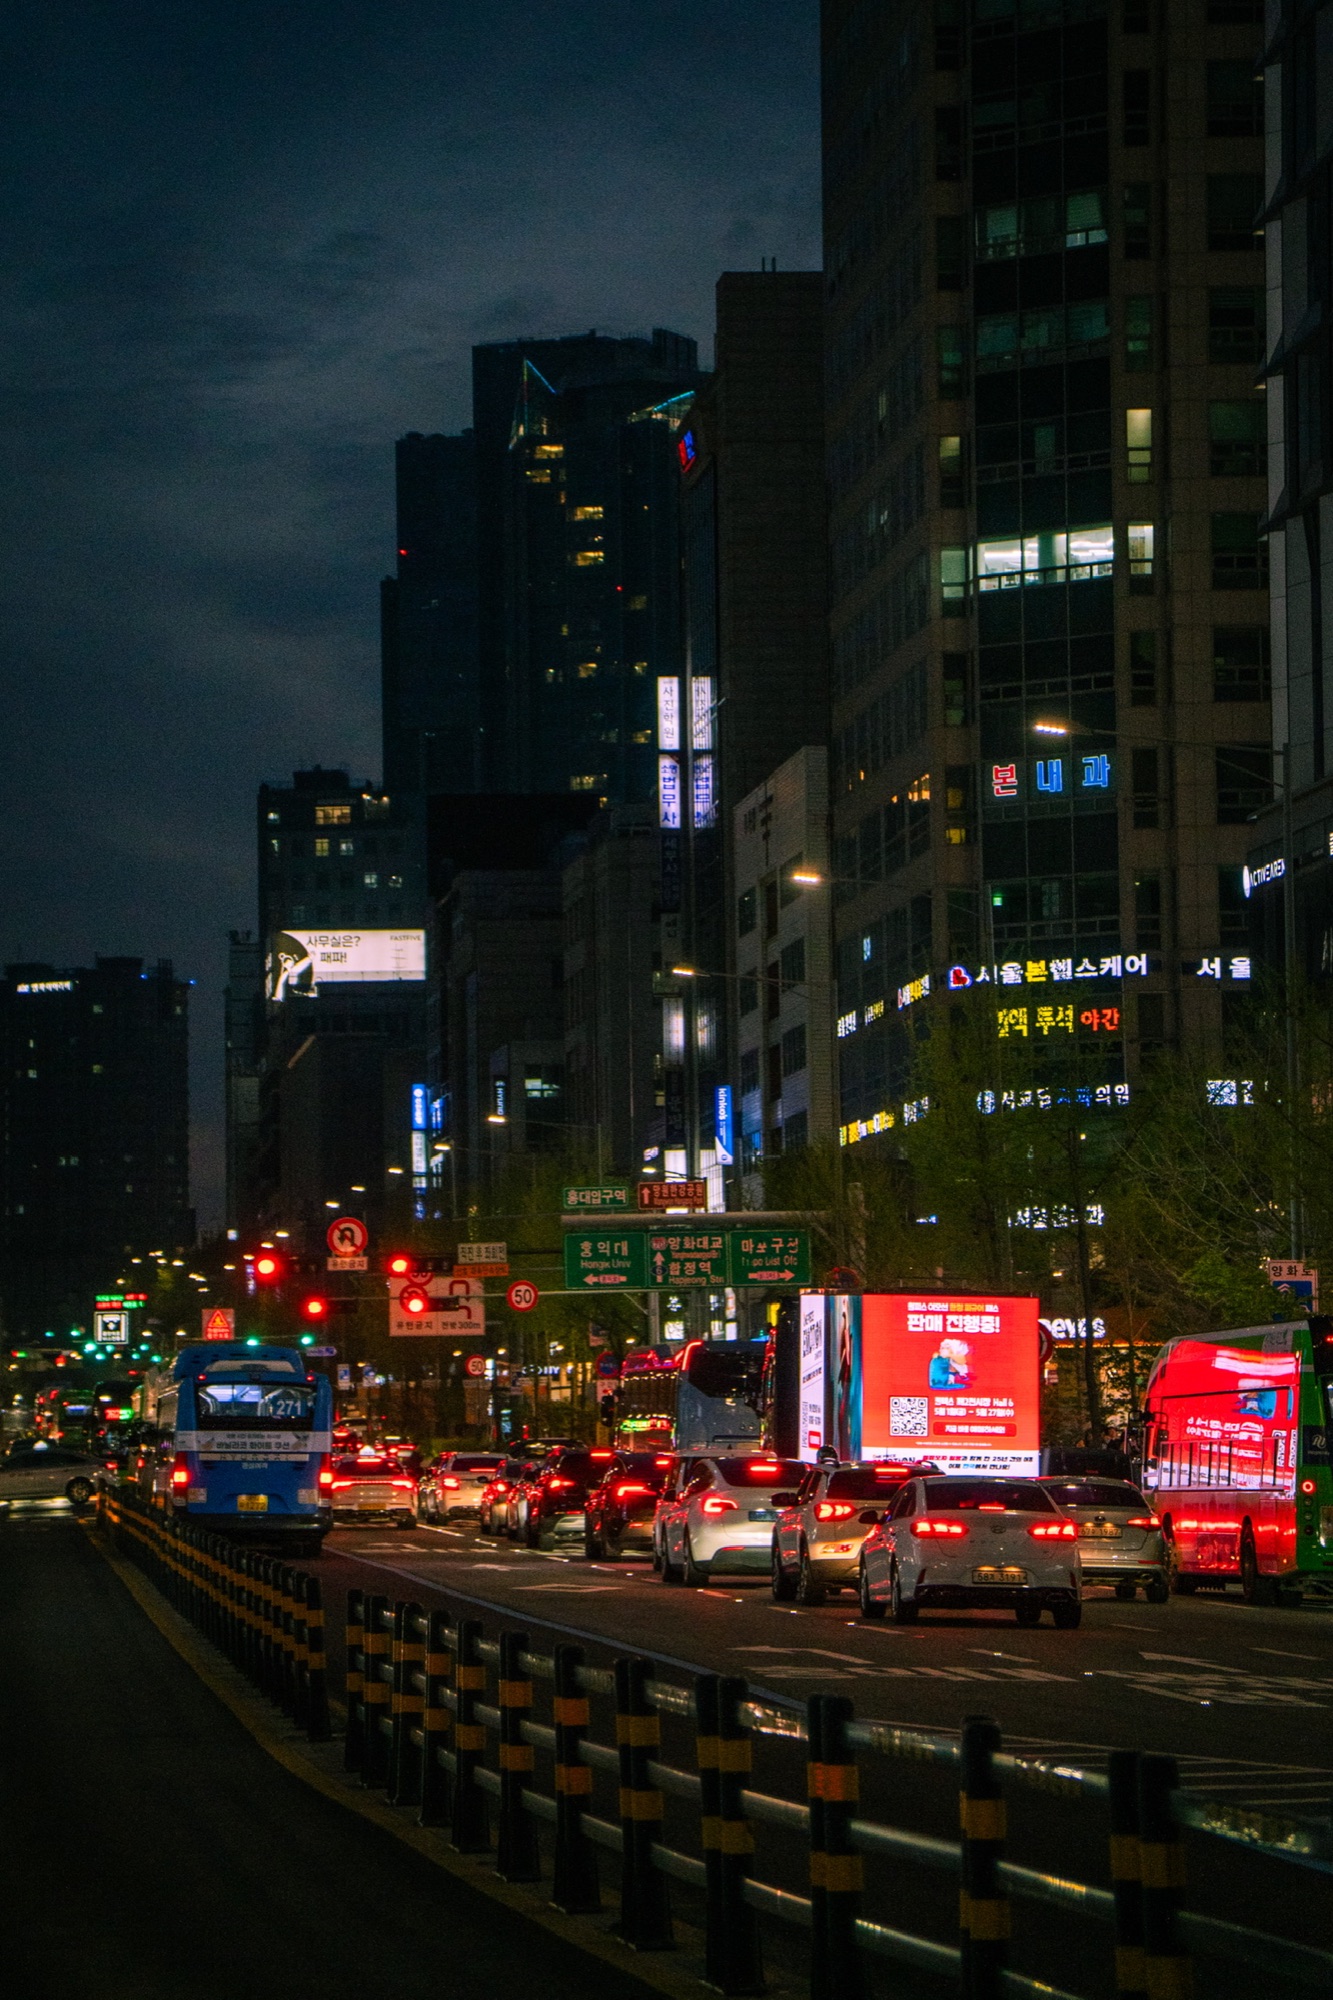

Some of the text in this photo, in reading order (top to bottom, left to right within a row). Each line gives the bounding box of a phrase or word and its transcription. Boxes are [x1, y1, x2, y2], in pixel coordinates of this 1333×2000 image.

[992, 754, 1110, 797] 본내과
[661, 776, 678, 825] 법무사
[306, 935, 361, 947] 사무실은?
[1080, 1008, 1120, 1031] 야간
[567, 1189, 626, 1205] 홍대입구역
[580, 1241, 628, 1257] 홍익대
[668, 1236, 723, 1250] 양화대교
[669, 1262, 711, 1275] 합정역
[1271, 1265, 1313, 1277] 양화로
[514, 1289, 532, 1304] 50
[907, 1314, 1000, 1333] 판매 진행중!
[276, 1400, 301, 1415] 271
